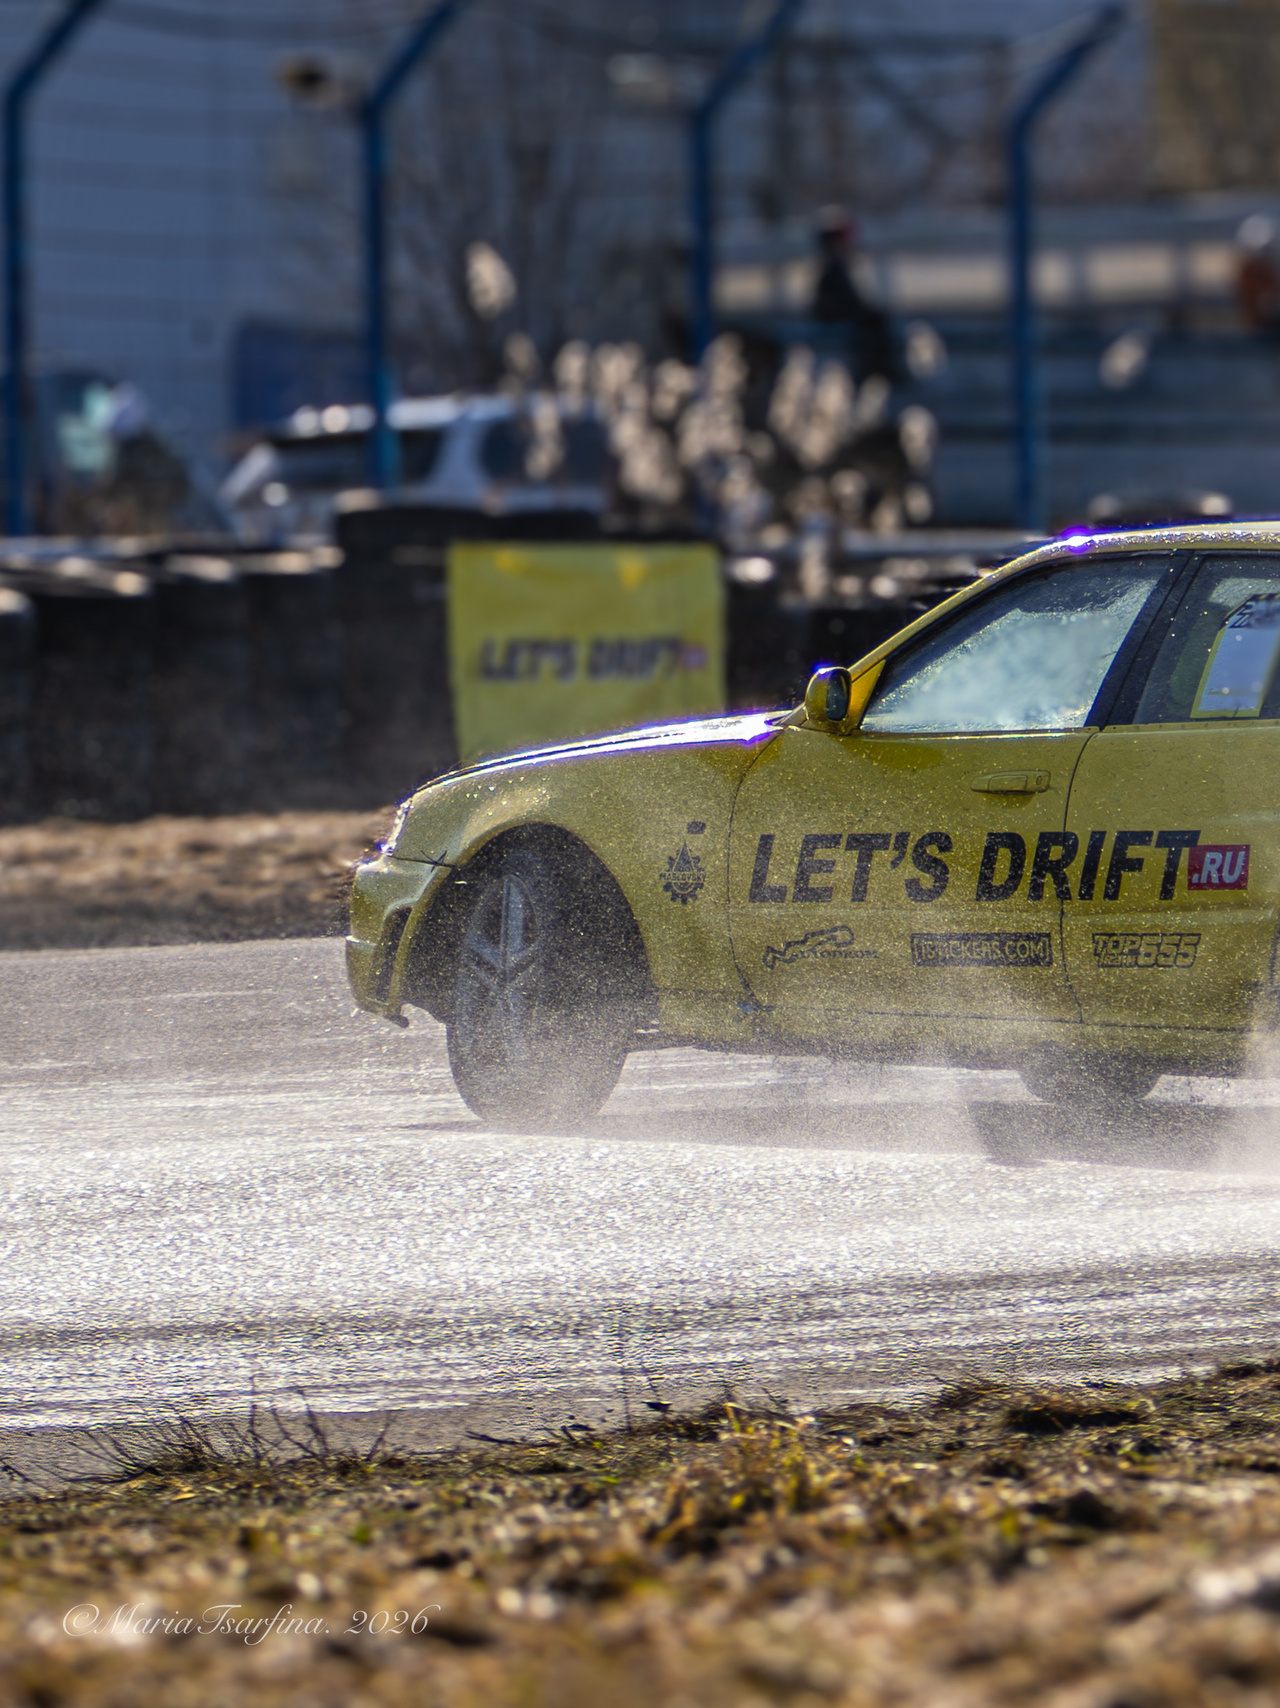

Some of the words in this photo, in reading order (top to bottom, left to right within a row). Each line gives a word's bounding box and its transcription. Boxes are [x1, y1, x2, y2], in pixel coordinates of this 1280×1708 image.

[748, 831, 954, 903] LET'S
[975, 830, 1202, 902] DRIFT
[1191, 850, 1246, 884] .RU
